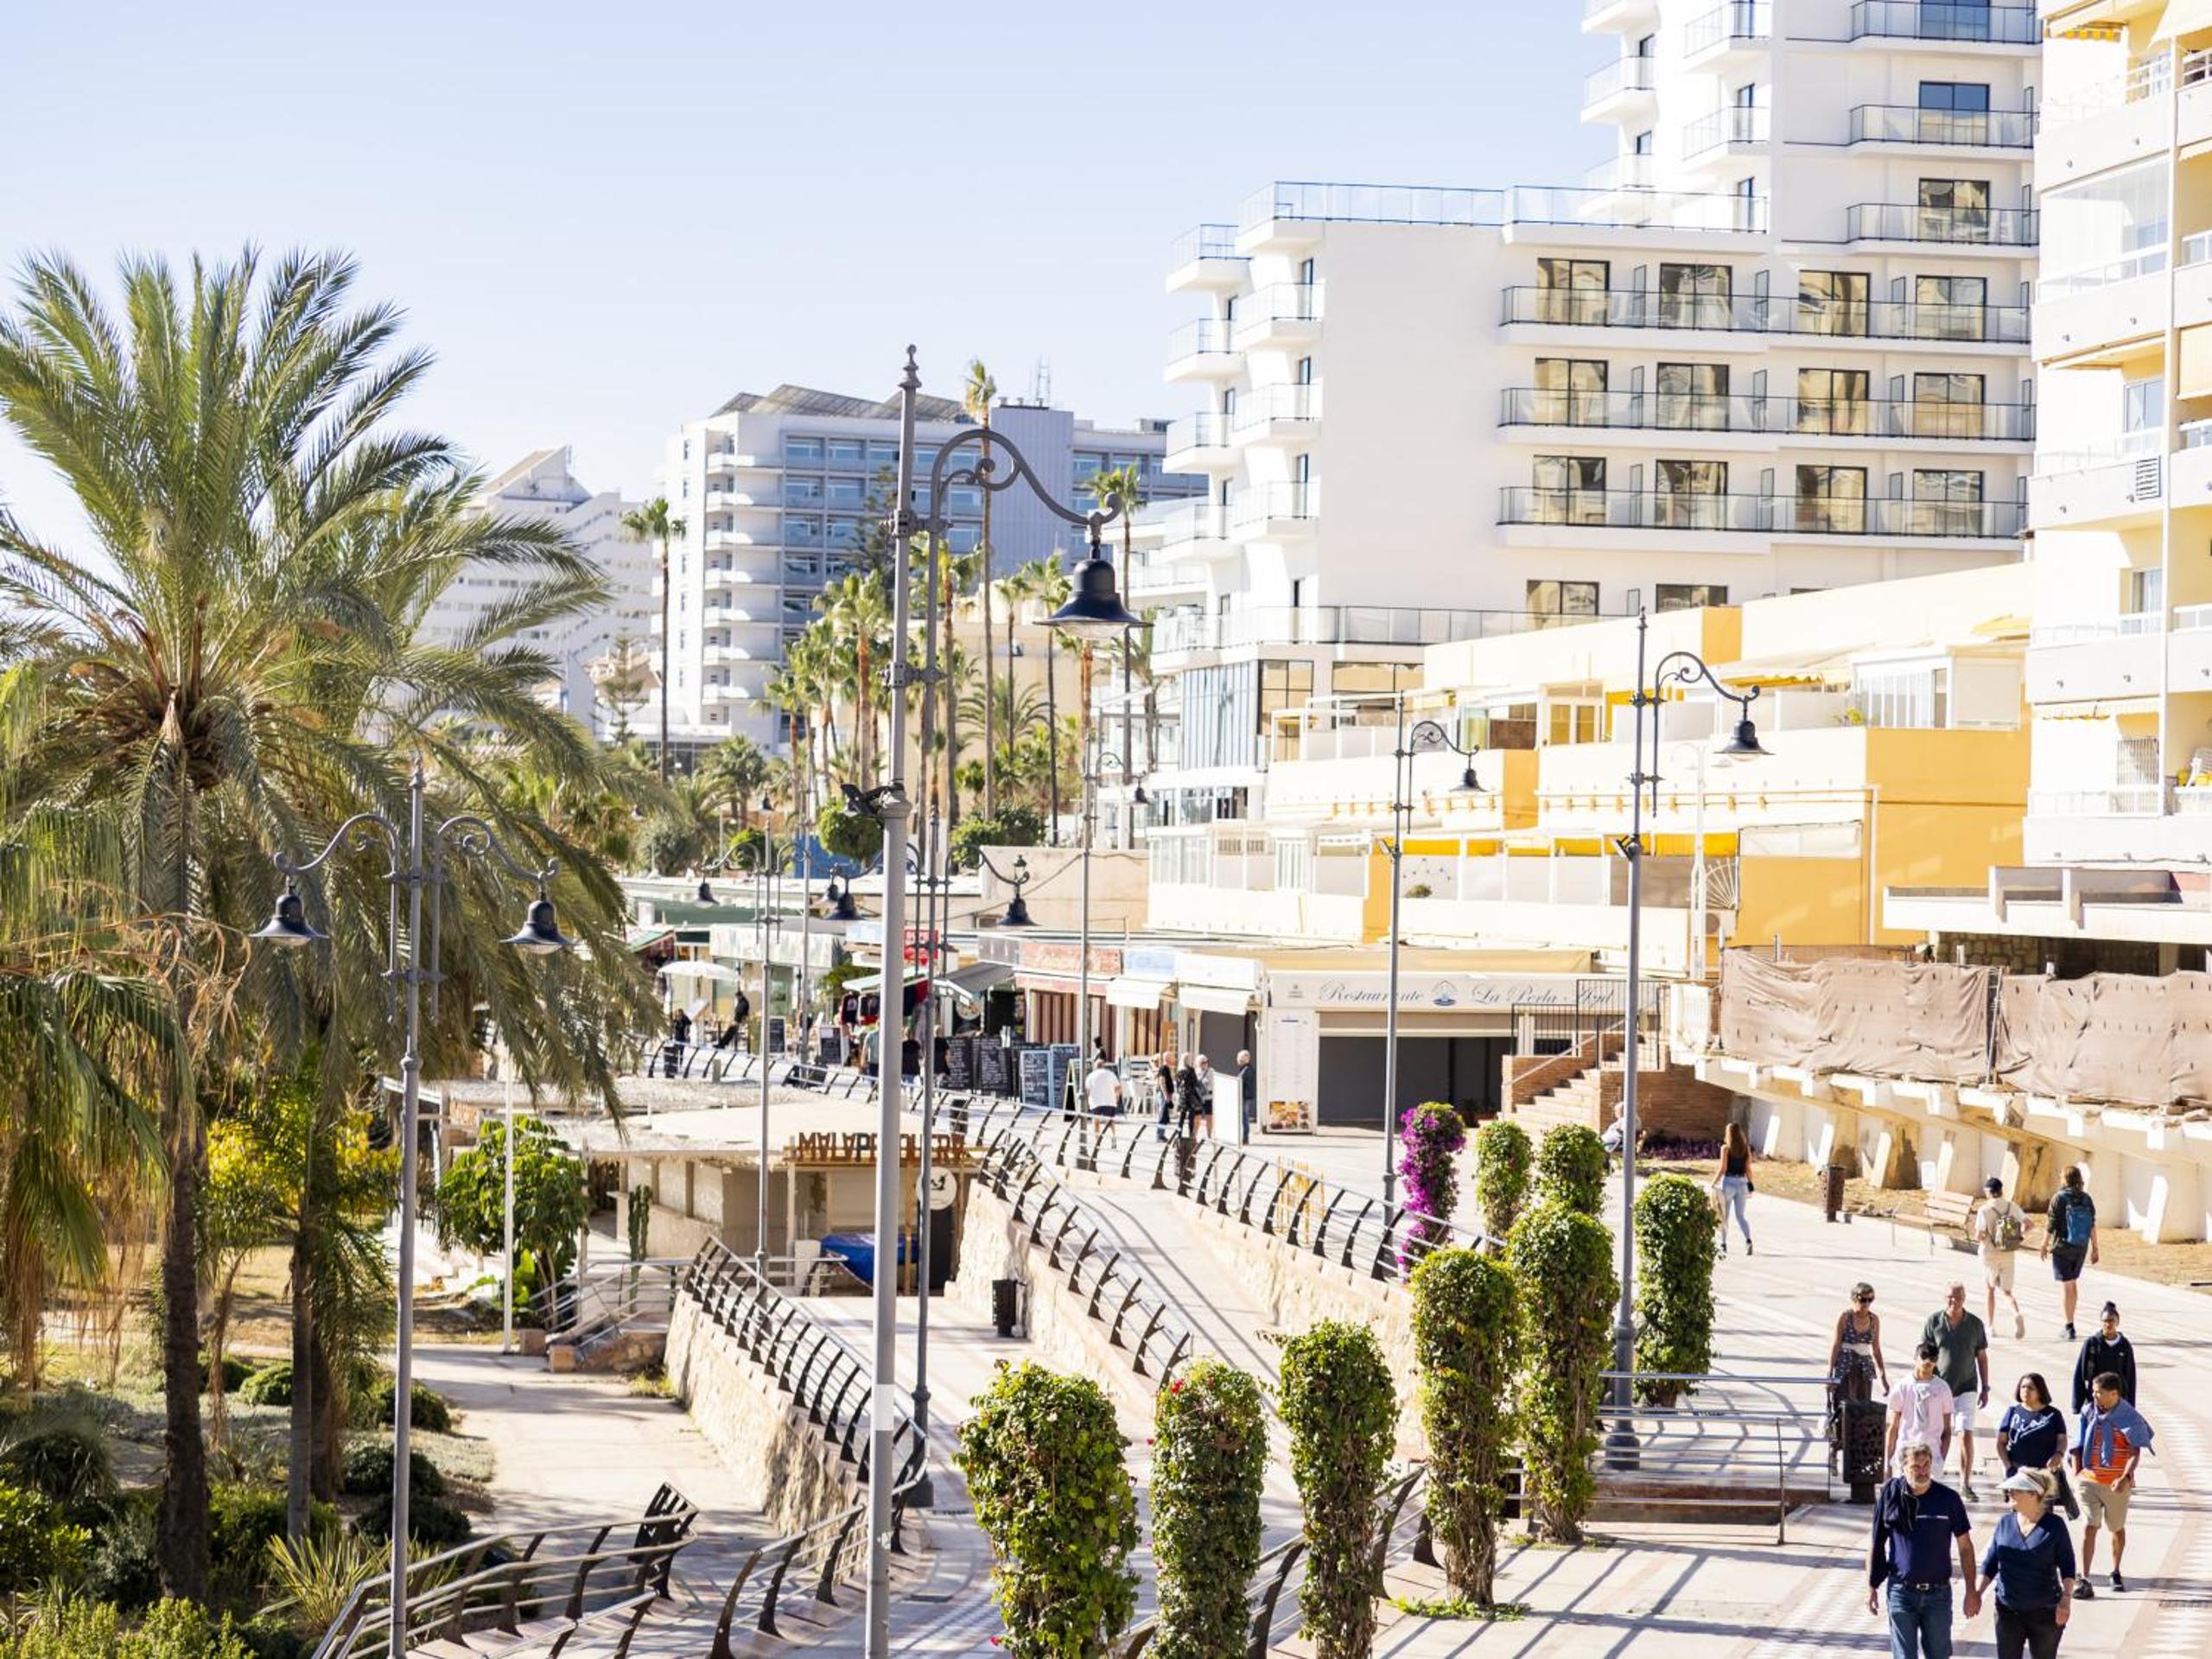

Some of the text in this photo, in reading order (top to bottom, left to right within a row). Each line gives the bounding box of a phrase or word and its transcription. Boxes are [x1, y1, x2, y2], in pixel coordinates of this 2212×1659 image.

[1319, 980, 1424, 1003] Restaurnte
[1471, 982, 1500, 1004] La
[1506, 983, 1558, 1003] Perla
